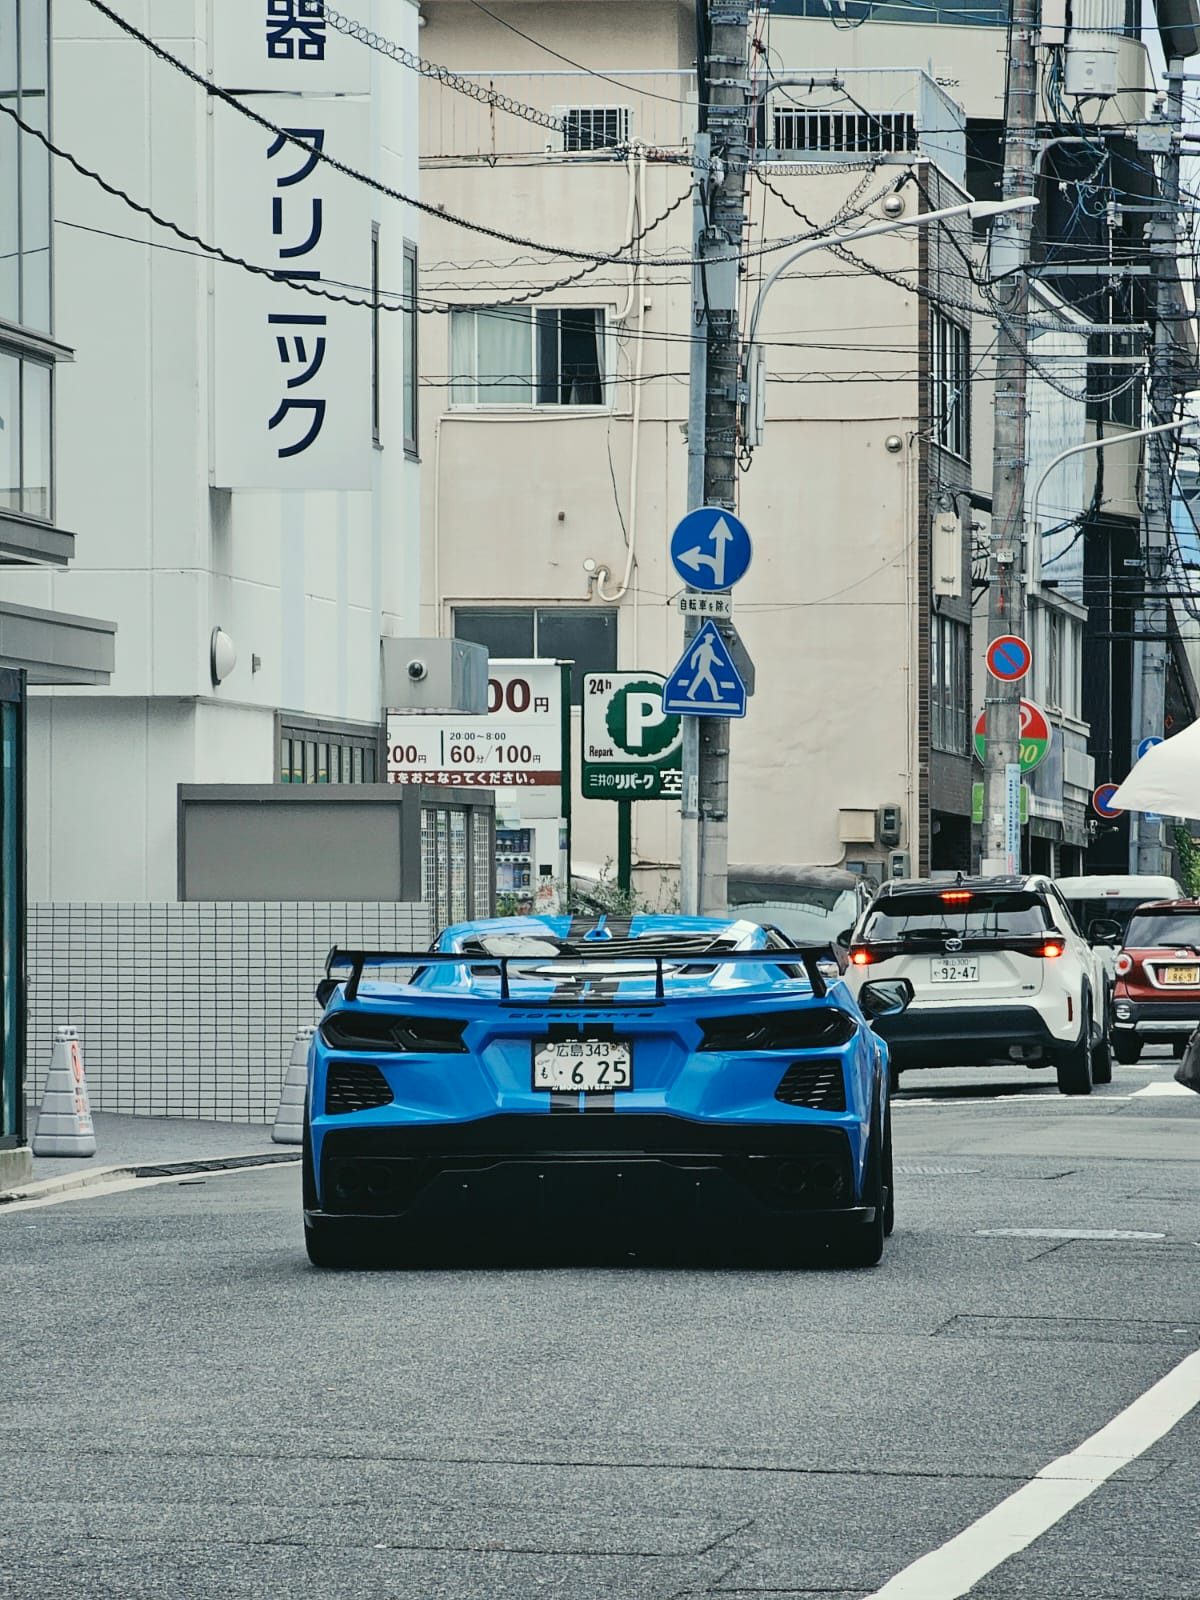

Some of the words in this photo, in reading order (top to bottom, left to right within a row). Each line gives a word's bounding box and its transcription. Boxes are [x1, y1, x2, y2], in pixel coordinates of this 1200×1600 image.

[266, 0, 326, 60] 器
[266, 128, 327, 458] クリニック
[680, 598, 729, 613] 自転車を除く
[589, 679, 612, 695] 24h
[626, 692, 667, 747] P
[589, 746, 613, 758] Repark
[589, 773, 654, 789] 三井のリパーク
